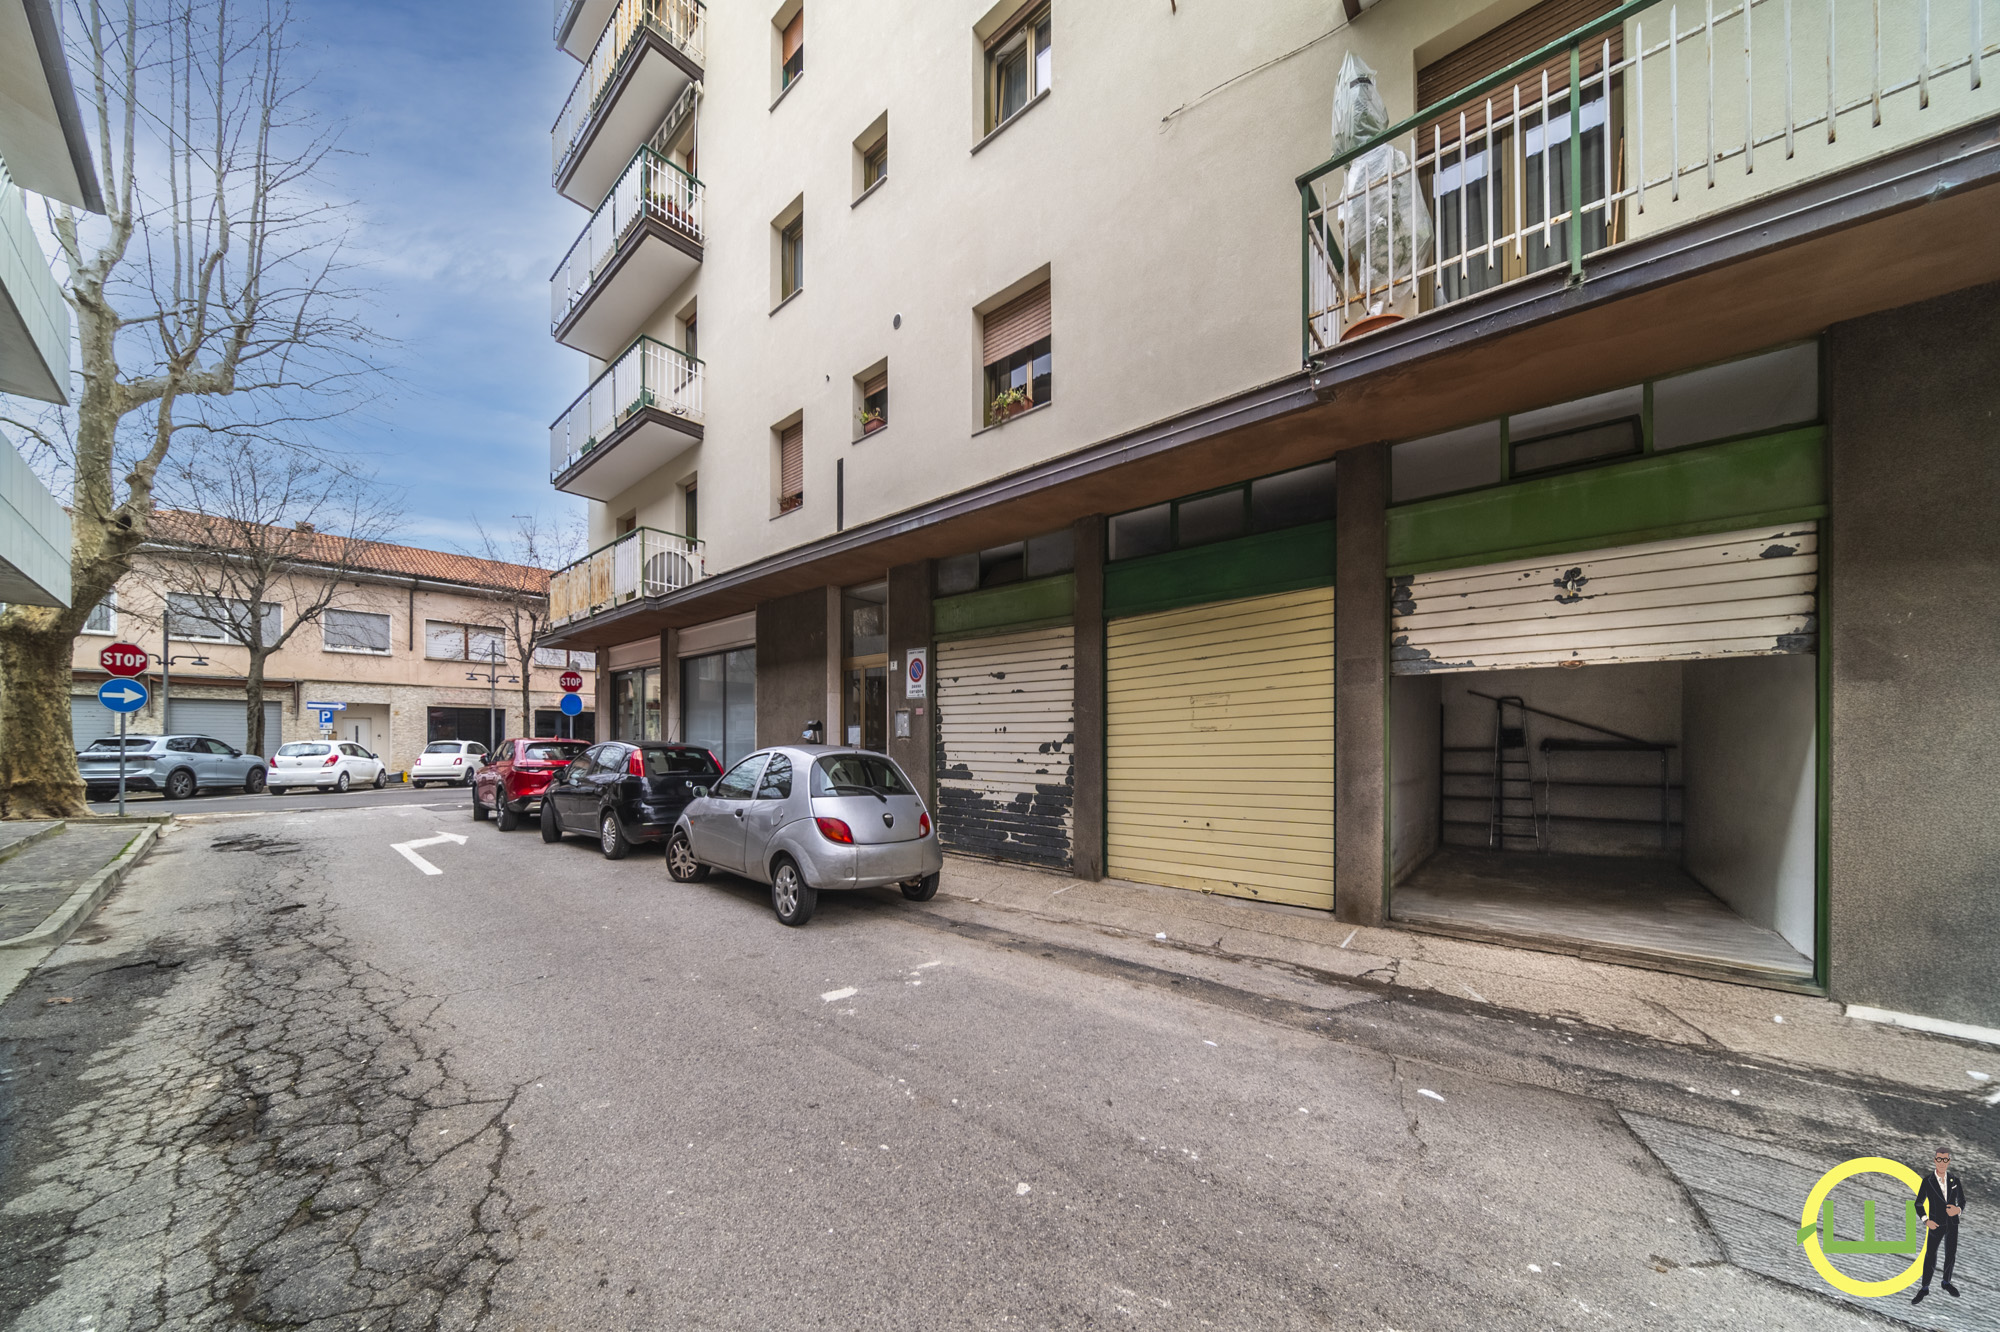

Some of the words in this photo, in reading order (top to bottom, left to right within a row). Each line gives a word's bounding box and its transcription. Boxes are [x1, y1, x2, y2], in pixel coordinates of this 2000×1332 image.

[102, 652, 146, 668] STOP
[561, 677, 581, 686] STOP
[322, 711, 331, 722] P
